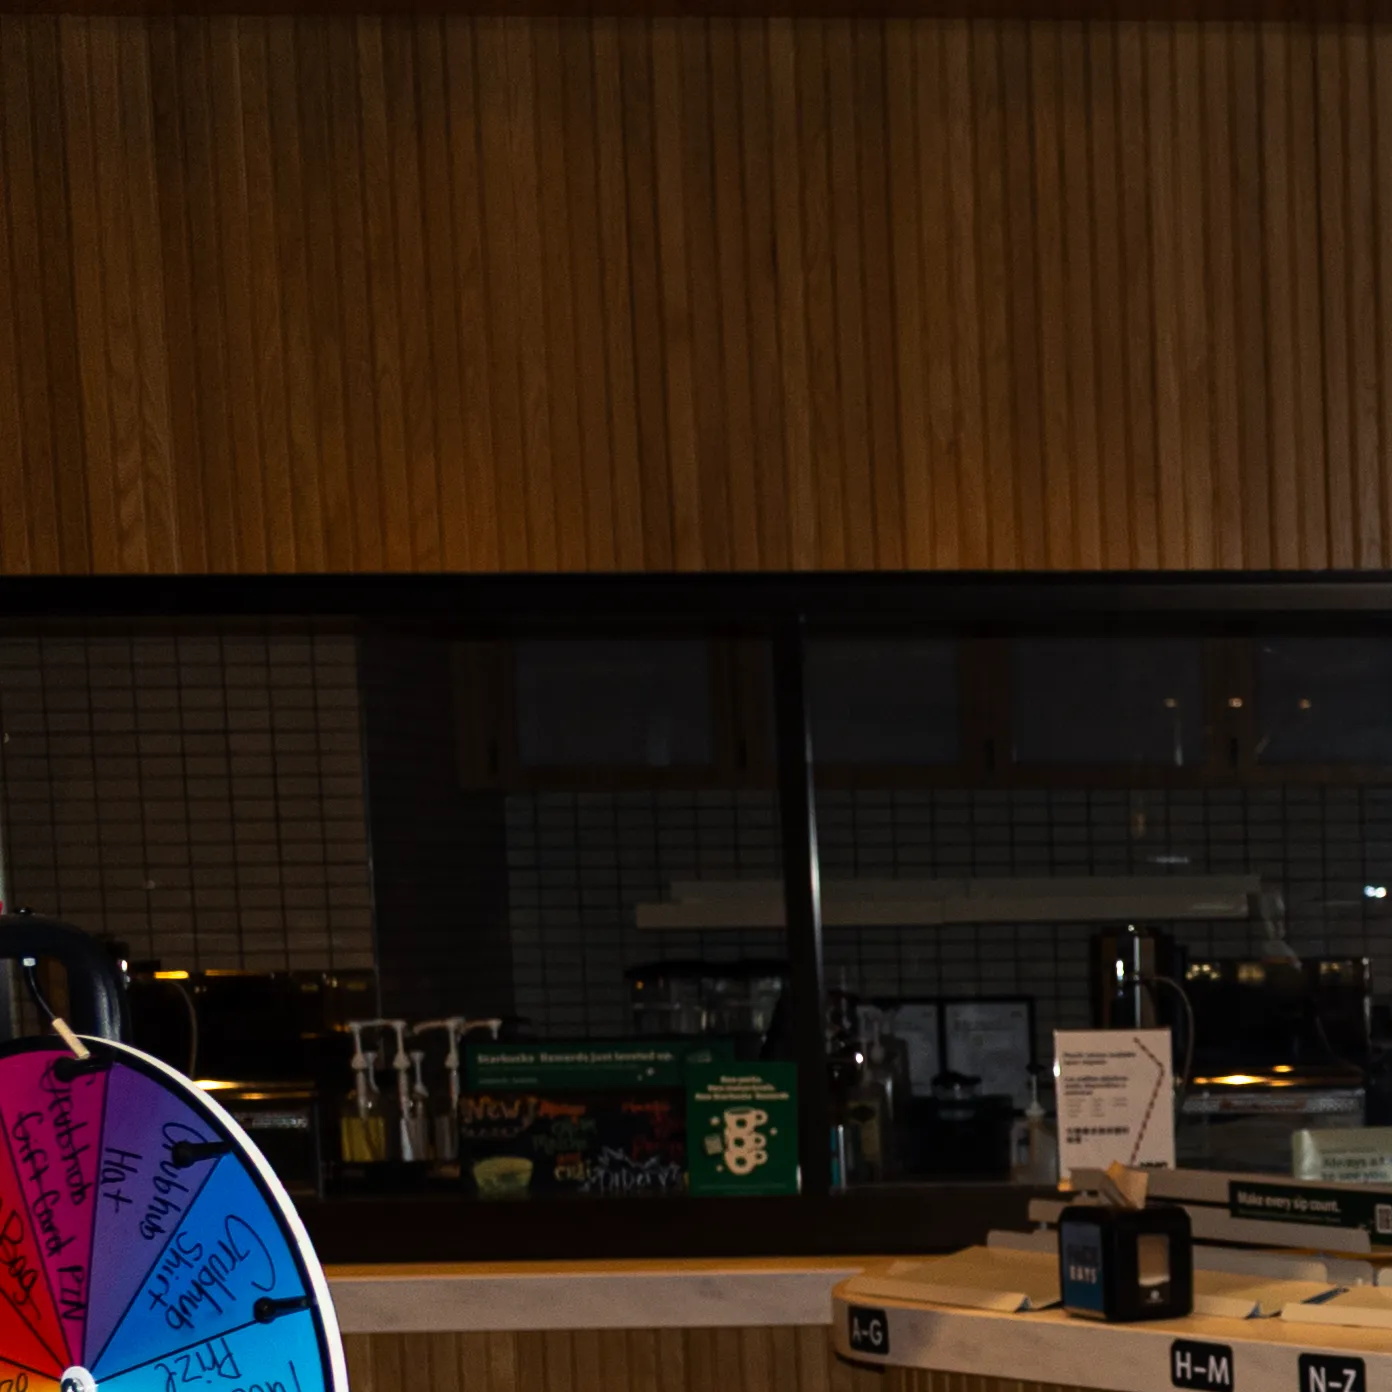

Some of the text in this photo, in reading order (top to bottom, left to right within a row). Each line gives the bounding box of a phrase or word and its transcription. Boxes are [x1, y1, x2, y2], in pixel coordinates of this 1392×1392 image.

[100, 1146, 143, 1214] Hat
[1264, 1196, 1291, 1212] every
[148, 1231, 203, 1311] Shirt
[852, 1317, 883, 1347] A-G
[1175, 1350, 1231, 1386] H-M
